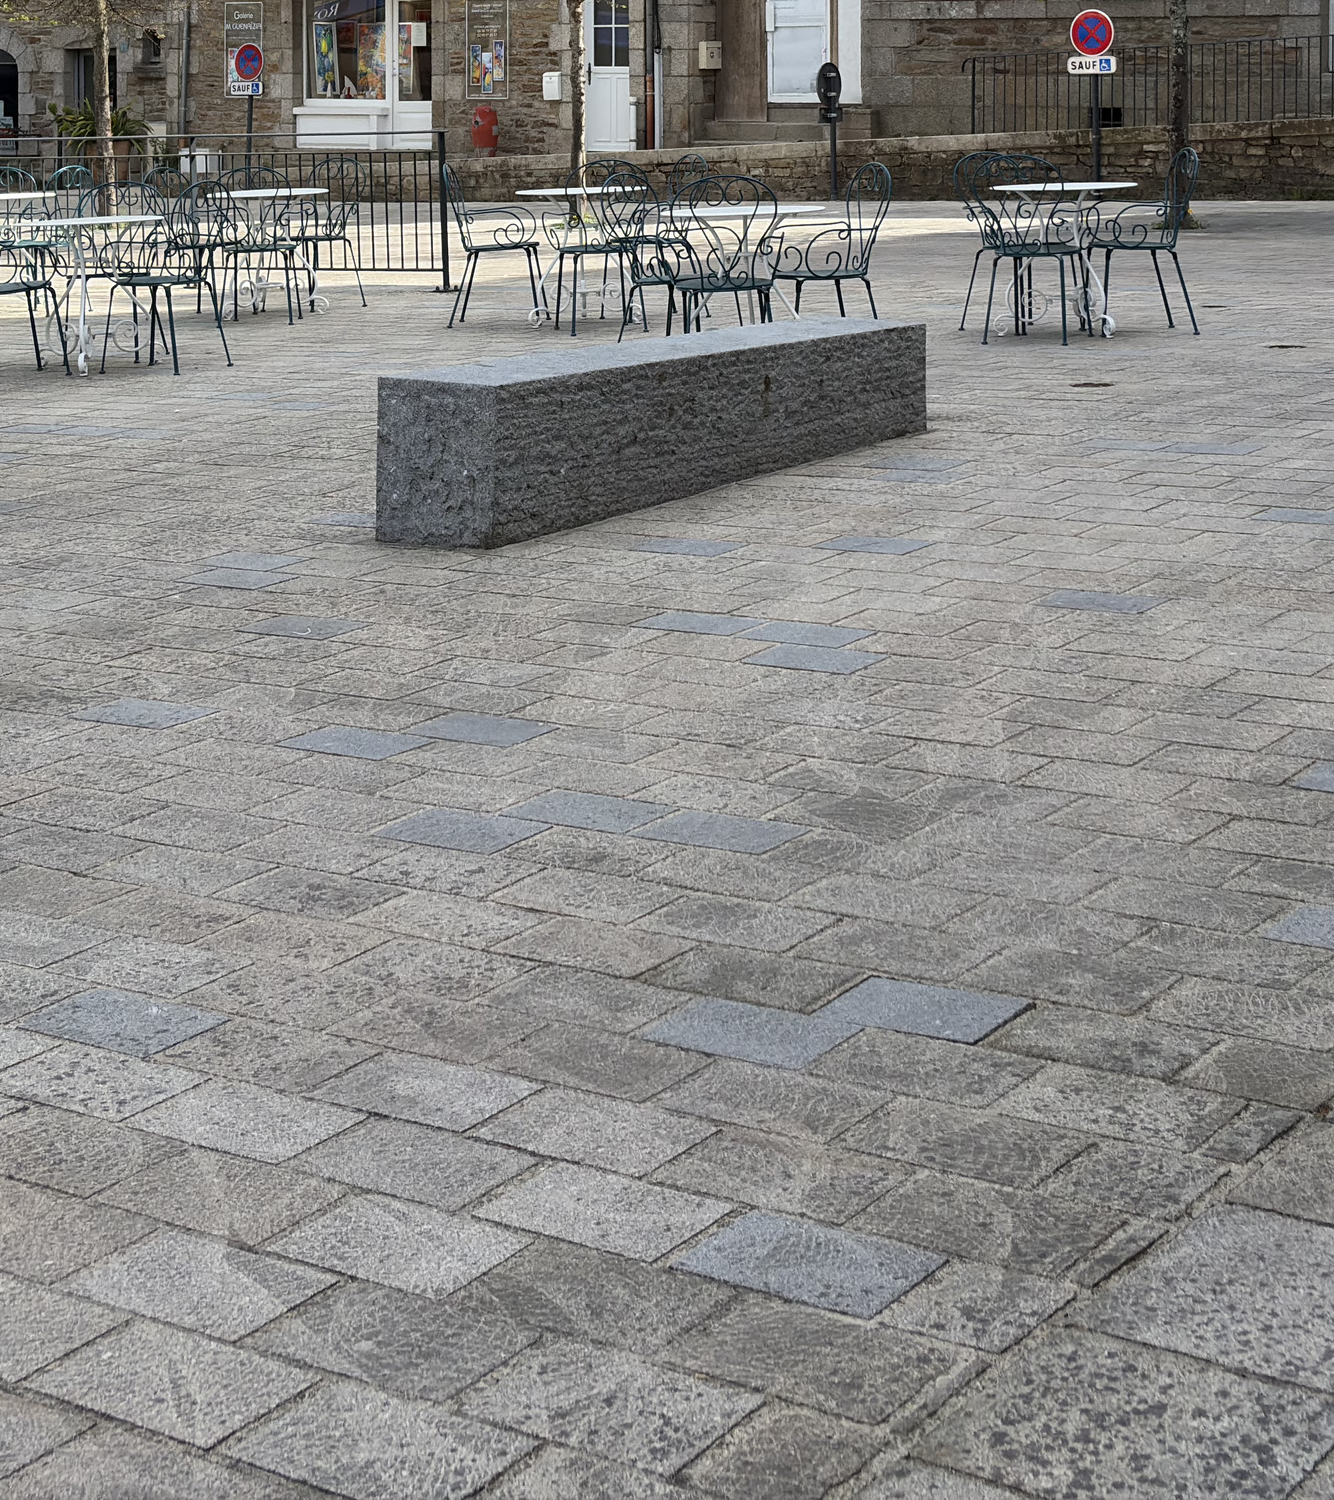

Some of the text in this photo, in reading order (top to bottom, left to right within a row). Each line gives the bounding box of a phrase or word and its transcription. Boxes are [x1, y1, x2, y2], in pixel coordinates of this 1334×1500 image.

[234, 10, 254, 20] Galerie
[1070, 61, 1097, 71] SAUF
[232, 84, 250, 93] SAUF
